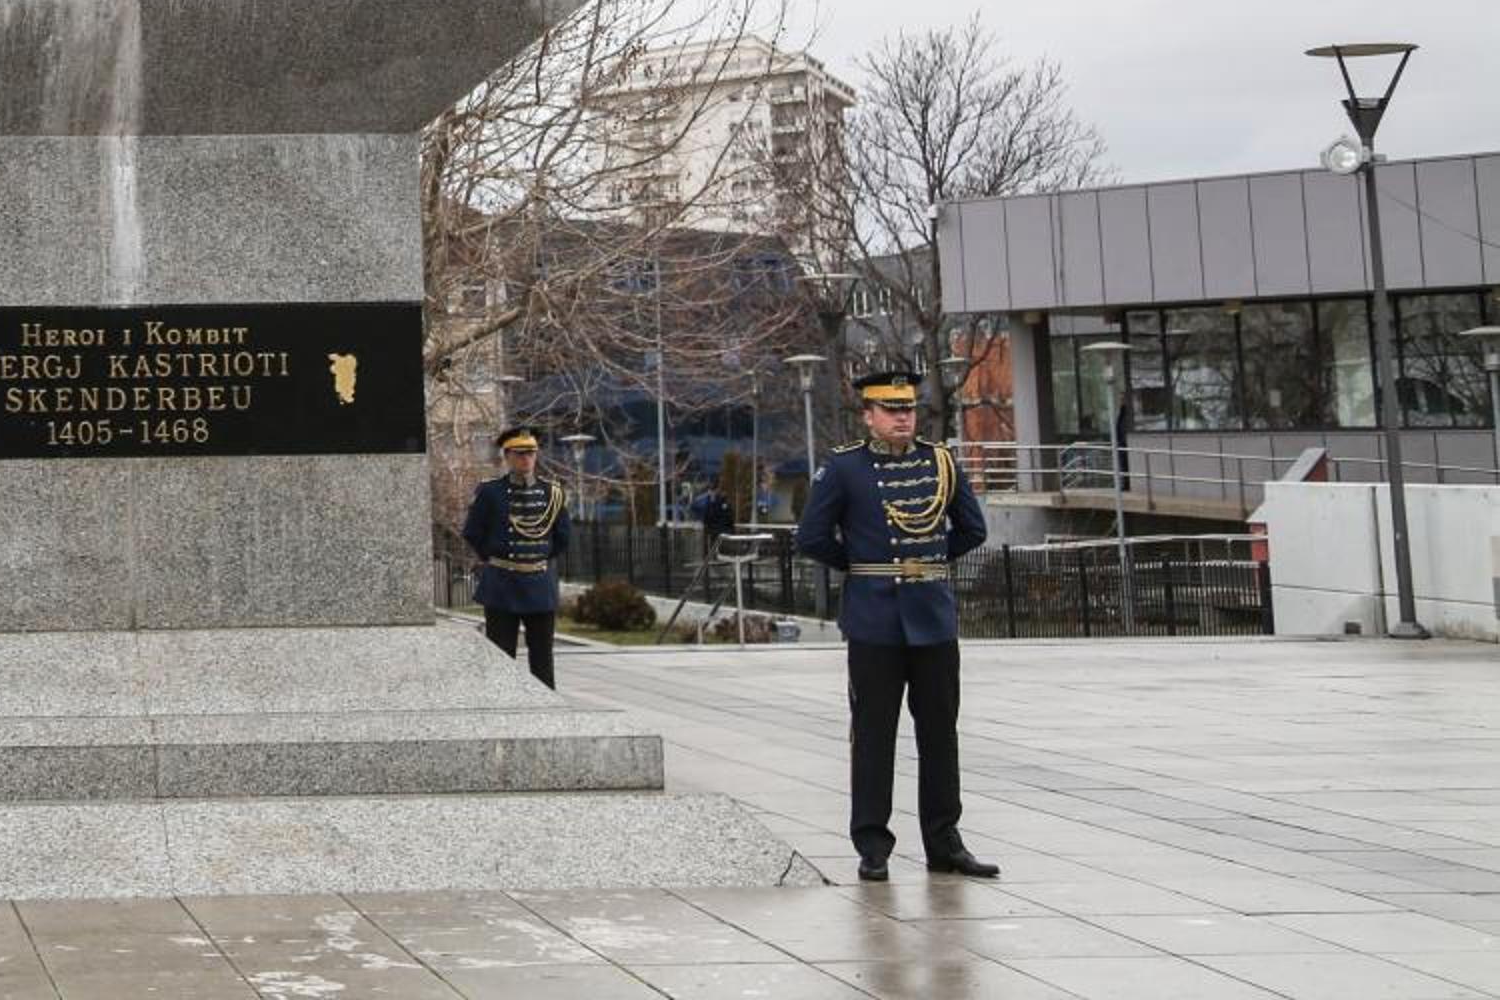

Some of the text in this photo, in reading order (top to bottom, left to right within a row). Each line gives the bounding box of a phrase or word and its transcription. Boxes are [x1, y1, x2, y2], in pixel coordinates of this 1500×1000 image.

[109, 351, 289, 378] KASTRIOTI
[5, 385, 252, 413] SKENDERBEU
[48, 417, 210, 445] 1405-1468
